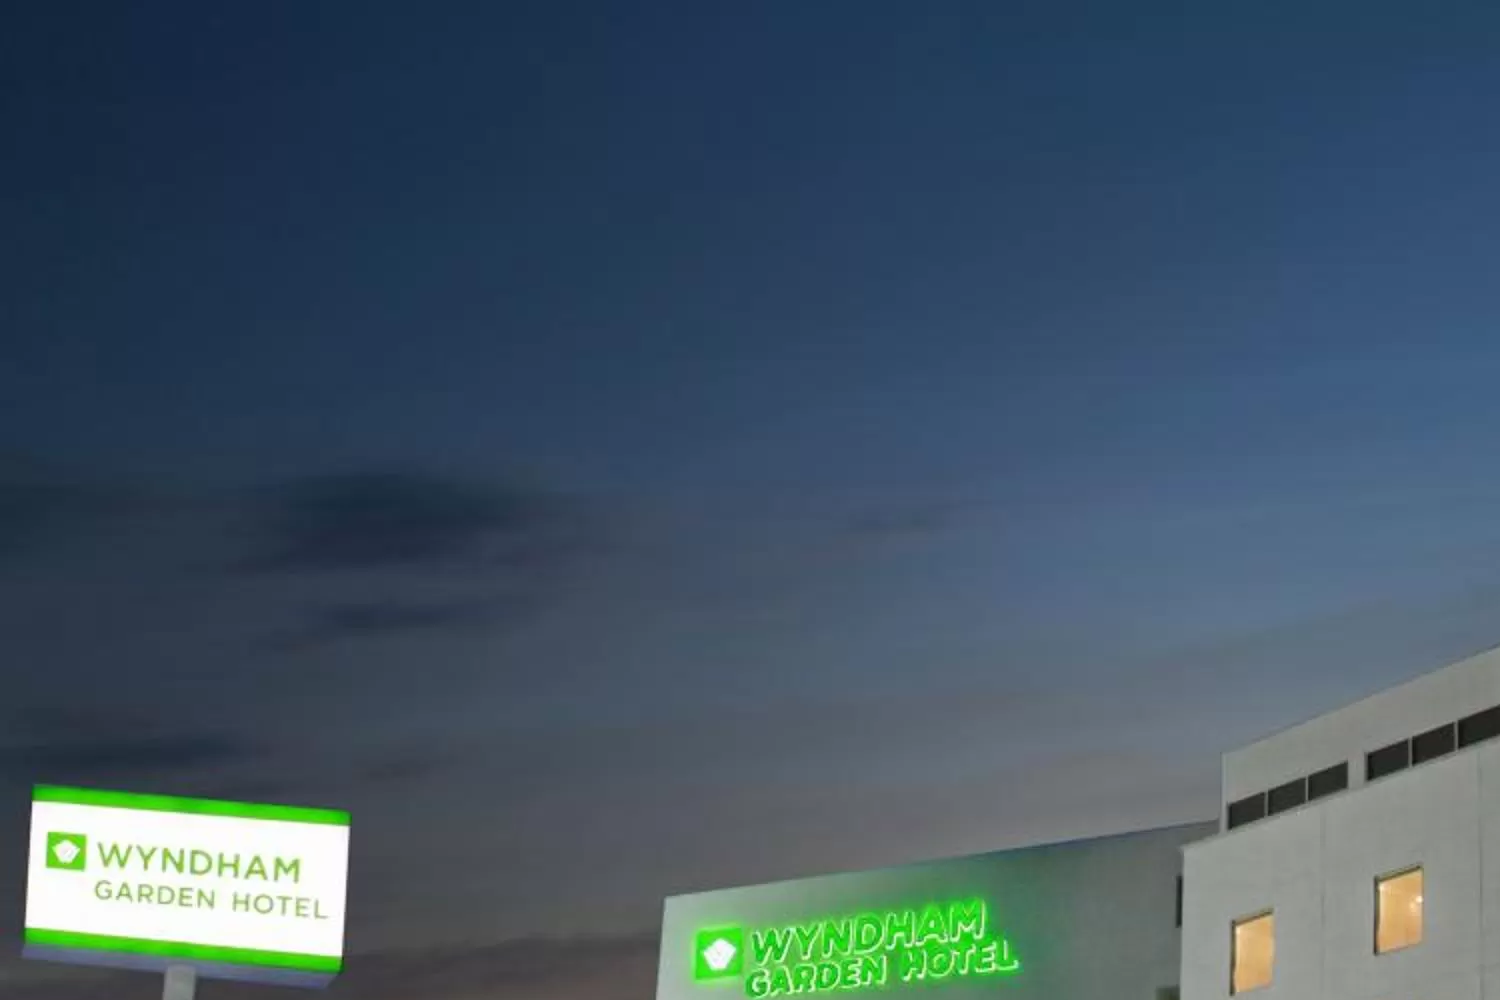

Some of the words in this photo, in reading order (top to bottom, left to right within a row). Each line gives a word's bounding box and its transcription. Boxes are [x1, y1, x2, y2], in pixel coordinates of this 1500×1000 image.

[97, 842, 301, 883] WYNDHAM
[94, 880, 215, 909] GARDEN
[231, 891, 329, 920] HOTEL
[751, 900, 985, 963] WYNDHAM
[747, 957, 887, 998] GARDEN
[903, 941, 1019, 981] HOTEL
